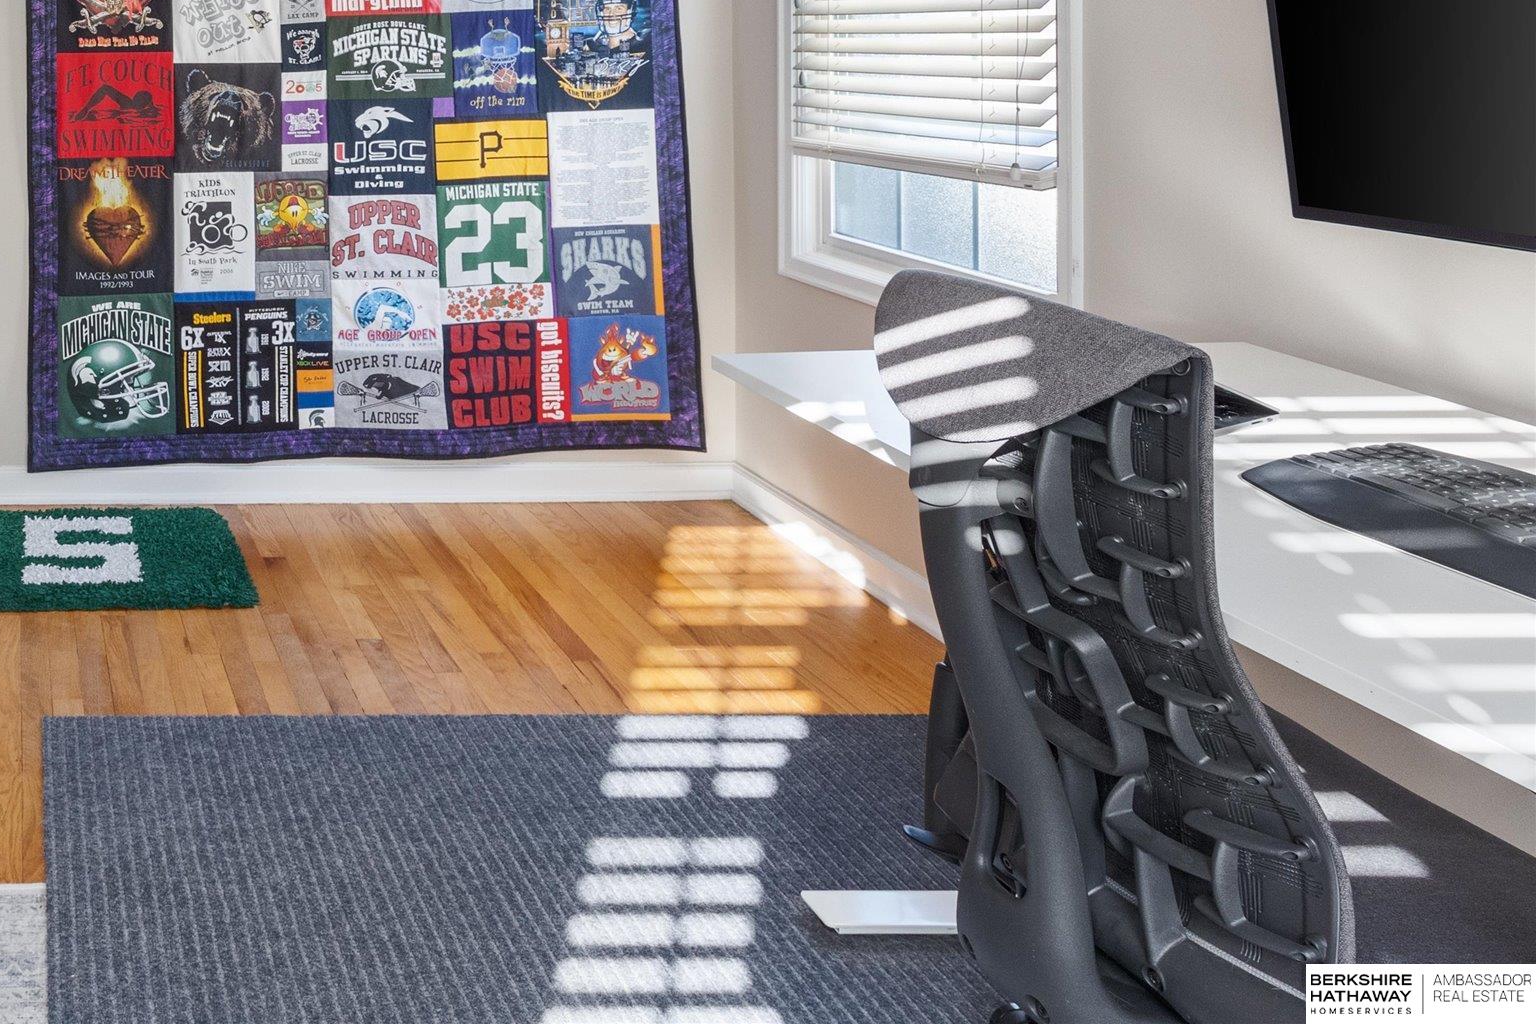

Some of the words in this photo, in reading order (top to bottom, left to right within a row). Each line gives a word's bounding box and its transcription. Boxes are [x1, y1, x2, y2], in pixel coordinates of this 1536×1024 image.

[78, 37, 96, 47] DEAD
[332, 28, 399, 57] MICHIGAN
[400, 28, 447, 54] STATE
[354, 45, 427, 67] SPARTANS
[99, 59, 173, 91] COUCH
[470, 96, 485, 109] off
[488, 95, 504, 106] the
[506, 95, 525, 106] rim
[581, 90, 596, 98] TIME
[62, 127, 171, 152] SWIMMING
[480, 130, 503, 168] P
[290, 157, 320, 165] LACROSSE
[334, 139, 427, 163] USC
[334, 163, 425, 175] Swimming
[184, 188, 236, 198] TRIATHLON
[198, 179, 221, 188] KIDS
[354, 180, 404, 188] Diving
[445, 183, 500, 201] MICHIGAN
[503, 182, 540, 196] STATE
[348, 199, 421, 230] UPPER
[332, 233, 365, 267] ST.
[373, 229, 438, 267] CLAIR
[444, 200, 544, 288] 23
[278, 261, 306, 273] NIKE
[560, 236, 647, 283] SHARKS
[75, 271, 111, 280] IMAGES
[130, 269, 155, 279] TOUR
[264, 274, 321, 289] SWIM
[332, 269, 438, 279] SWIMMING
[92, 301, 112, 312] WE
[116, 301, 142, 310] ARE
[577, 301, 603, 310] SWIM
[605, 299, 634, 309] TEAM
[193, 311, 232, 324] Steelers
[244, 311, 288, 321] PENGUINS
[62, 309, 128, 360] MICHIGAN
[131, 310, 172, 356] STATE
[181, 325, 205, 350] 6X
[271, 320, 295, 345] 3X
[338, 328, 360, 341] AGE
[367, 328, 402, 342] GROUP
[409, 328, 437, 340] OPEN
[450, 322, 531, 353] USC
[536, 321, 562, 347] got
[335, 354, 380, 374] UPPER
[382, 354, 402, 368] ST.
[404, 355, 442, 374] CLAIR
[450, 356, 531, 394] SWIM
[540, 349, 565, 420] biscuits?
[362, 410, 419, 424] LACROSSE
[451, 395, 531, 428] CLUB
[20, 514, 144, 586] S
